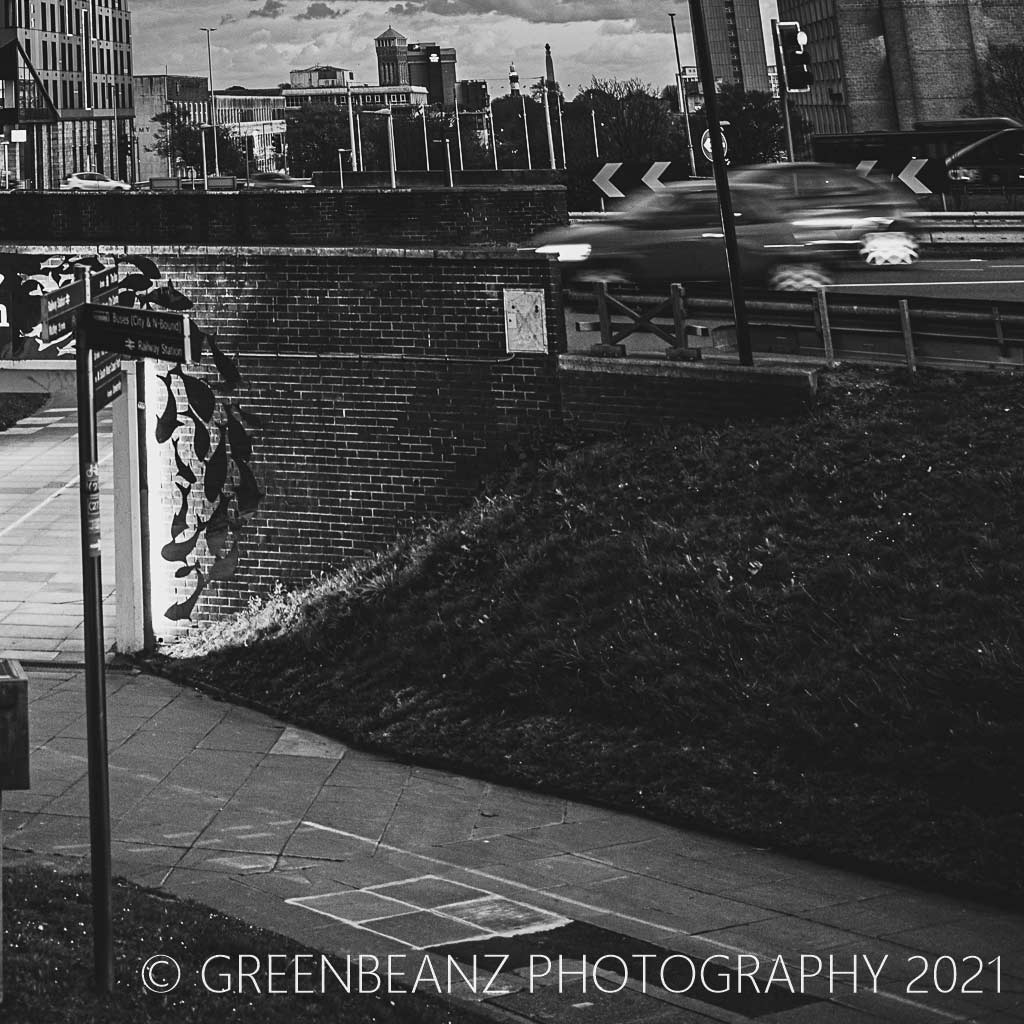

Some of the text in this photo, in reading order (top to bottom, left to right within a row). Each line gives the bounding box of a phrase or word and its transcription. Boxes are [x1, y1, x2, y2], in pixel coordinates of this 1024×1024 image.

[112, 312, 130, 325] Buses
[146, 317, 152, 328] &
[138, 340, 183, 356] Railway Station
